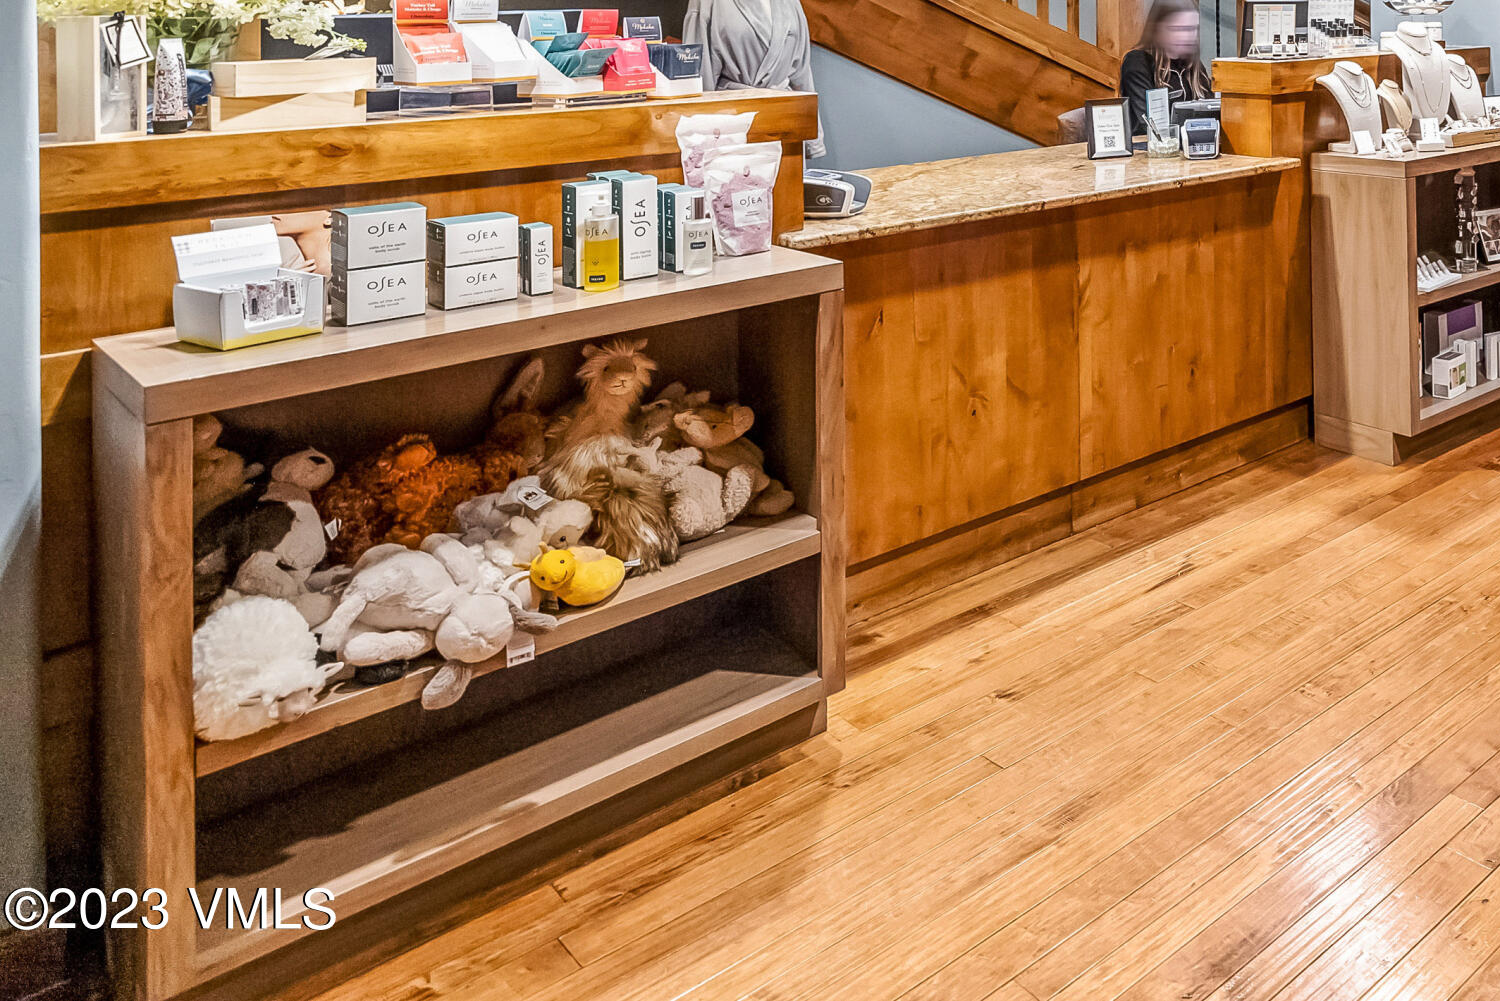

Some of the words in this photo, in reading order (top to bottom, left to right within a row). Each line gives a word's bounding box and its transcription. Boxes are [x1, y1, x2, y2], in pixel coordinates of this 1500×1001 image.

[739, 196, 763, 208] OSEA
[630, 198, 651, 238] OSEA
[367, 220, 407, 238] OSEA
[467, 229, 498, 244] OSEA
[688, 230, 709, 240] OSEA
[534, 239, 550, 266] OSEA
[366, 276, 407, 293] OSEA
[466, 271, 498, 286] OSEA
